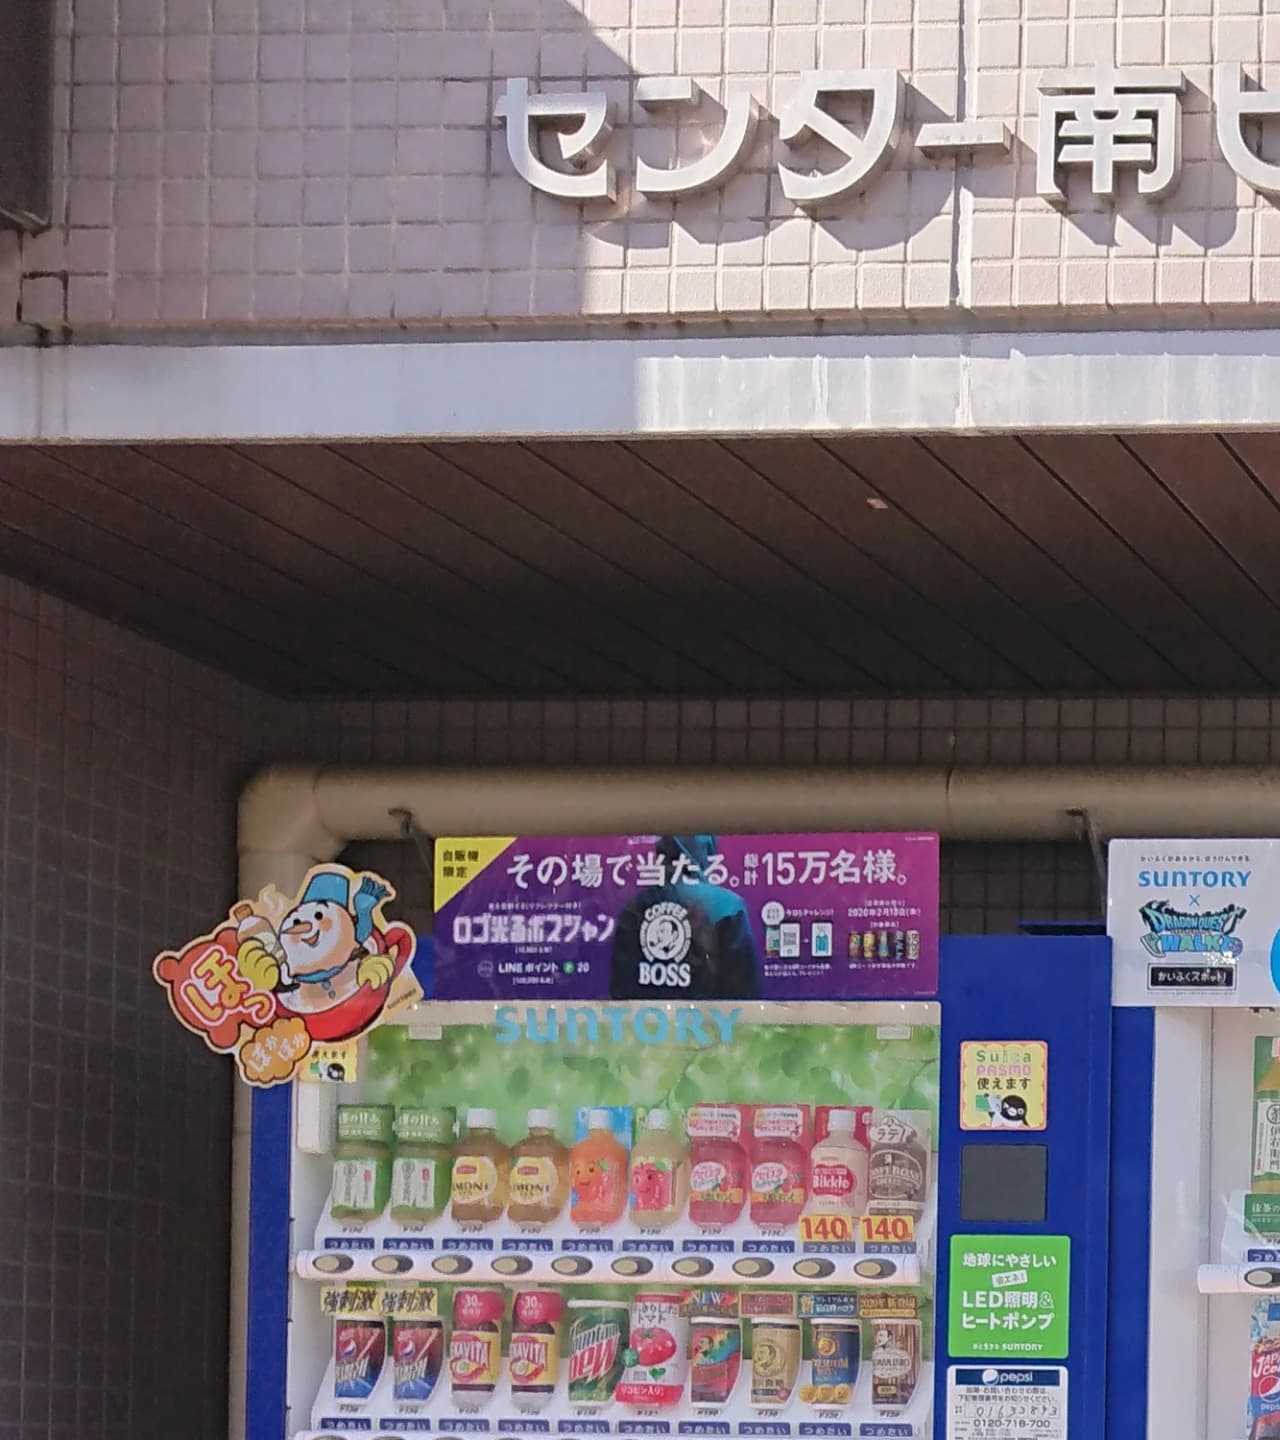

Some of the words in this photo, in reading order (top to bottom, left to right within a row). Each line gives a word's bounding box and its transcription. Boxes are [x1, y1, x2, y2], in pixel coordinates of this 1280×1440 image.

[442, 866, 468, 879] 限定
[506, 851, 740, 889] その場で当たる。
[1138, 870, 1252, 888] SUNTORY
[644, 901, 688, 921] COFFEE
[1159, 934, 1222, 952] WALK
[498, 962, 523, 974] LINE
[638, 961, 691, 987] BOSS
[494, 1005, 743, 1046] SUNTORY
[976, 1049, 1032, 1063] Suica
[976, 1064, 1032, 1077] PASMO
[977, 1077, 1031, 1090] 使えます
[962, 1252, 1057, 1268] 地球にやさしい
[962, 1290, 1055, 1309] LED照明&
[961, 1312, 1056, 1330] ヒートポンプ
[1001, 1343, 1043, 1351] SUNTORY
[1000, 1372, 1033, 1384] pepsi
[973, 1419, 1051, 1429] 0120-718-700
